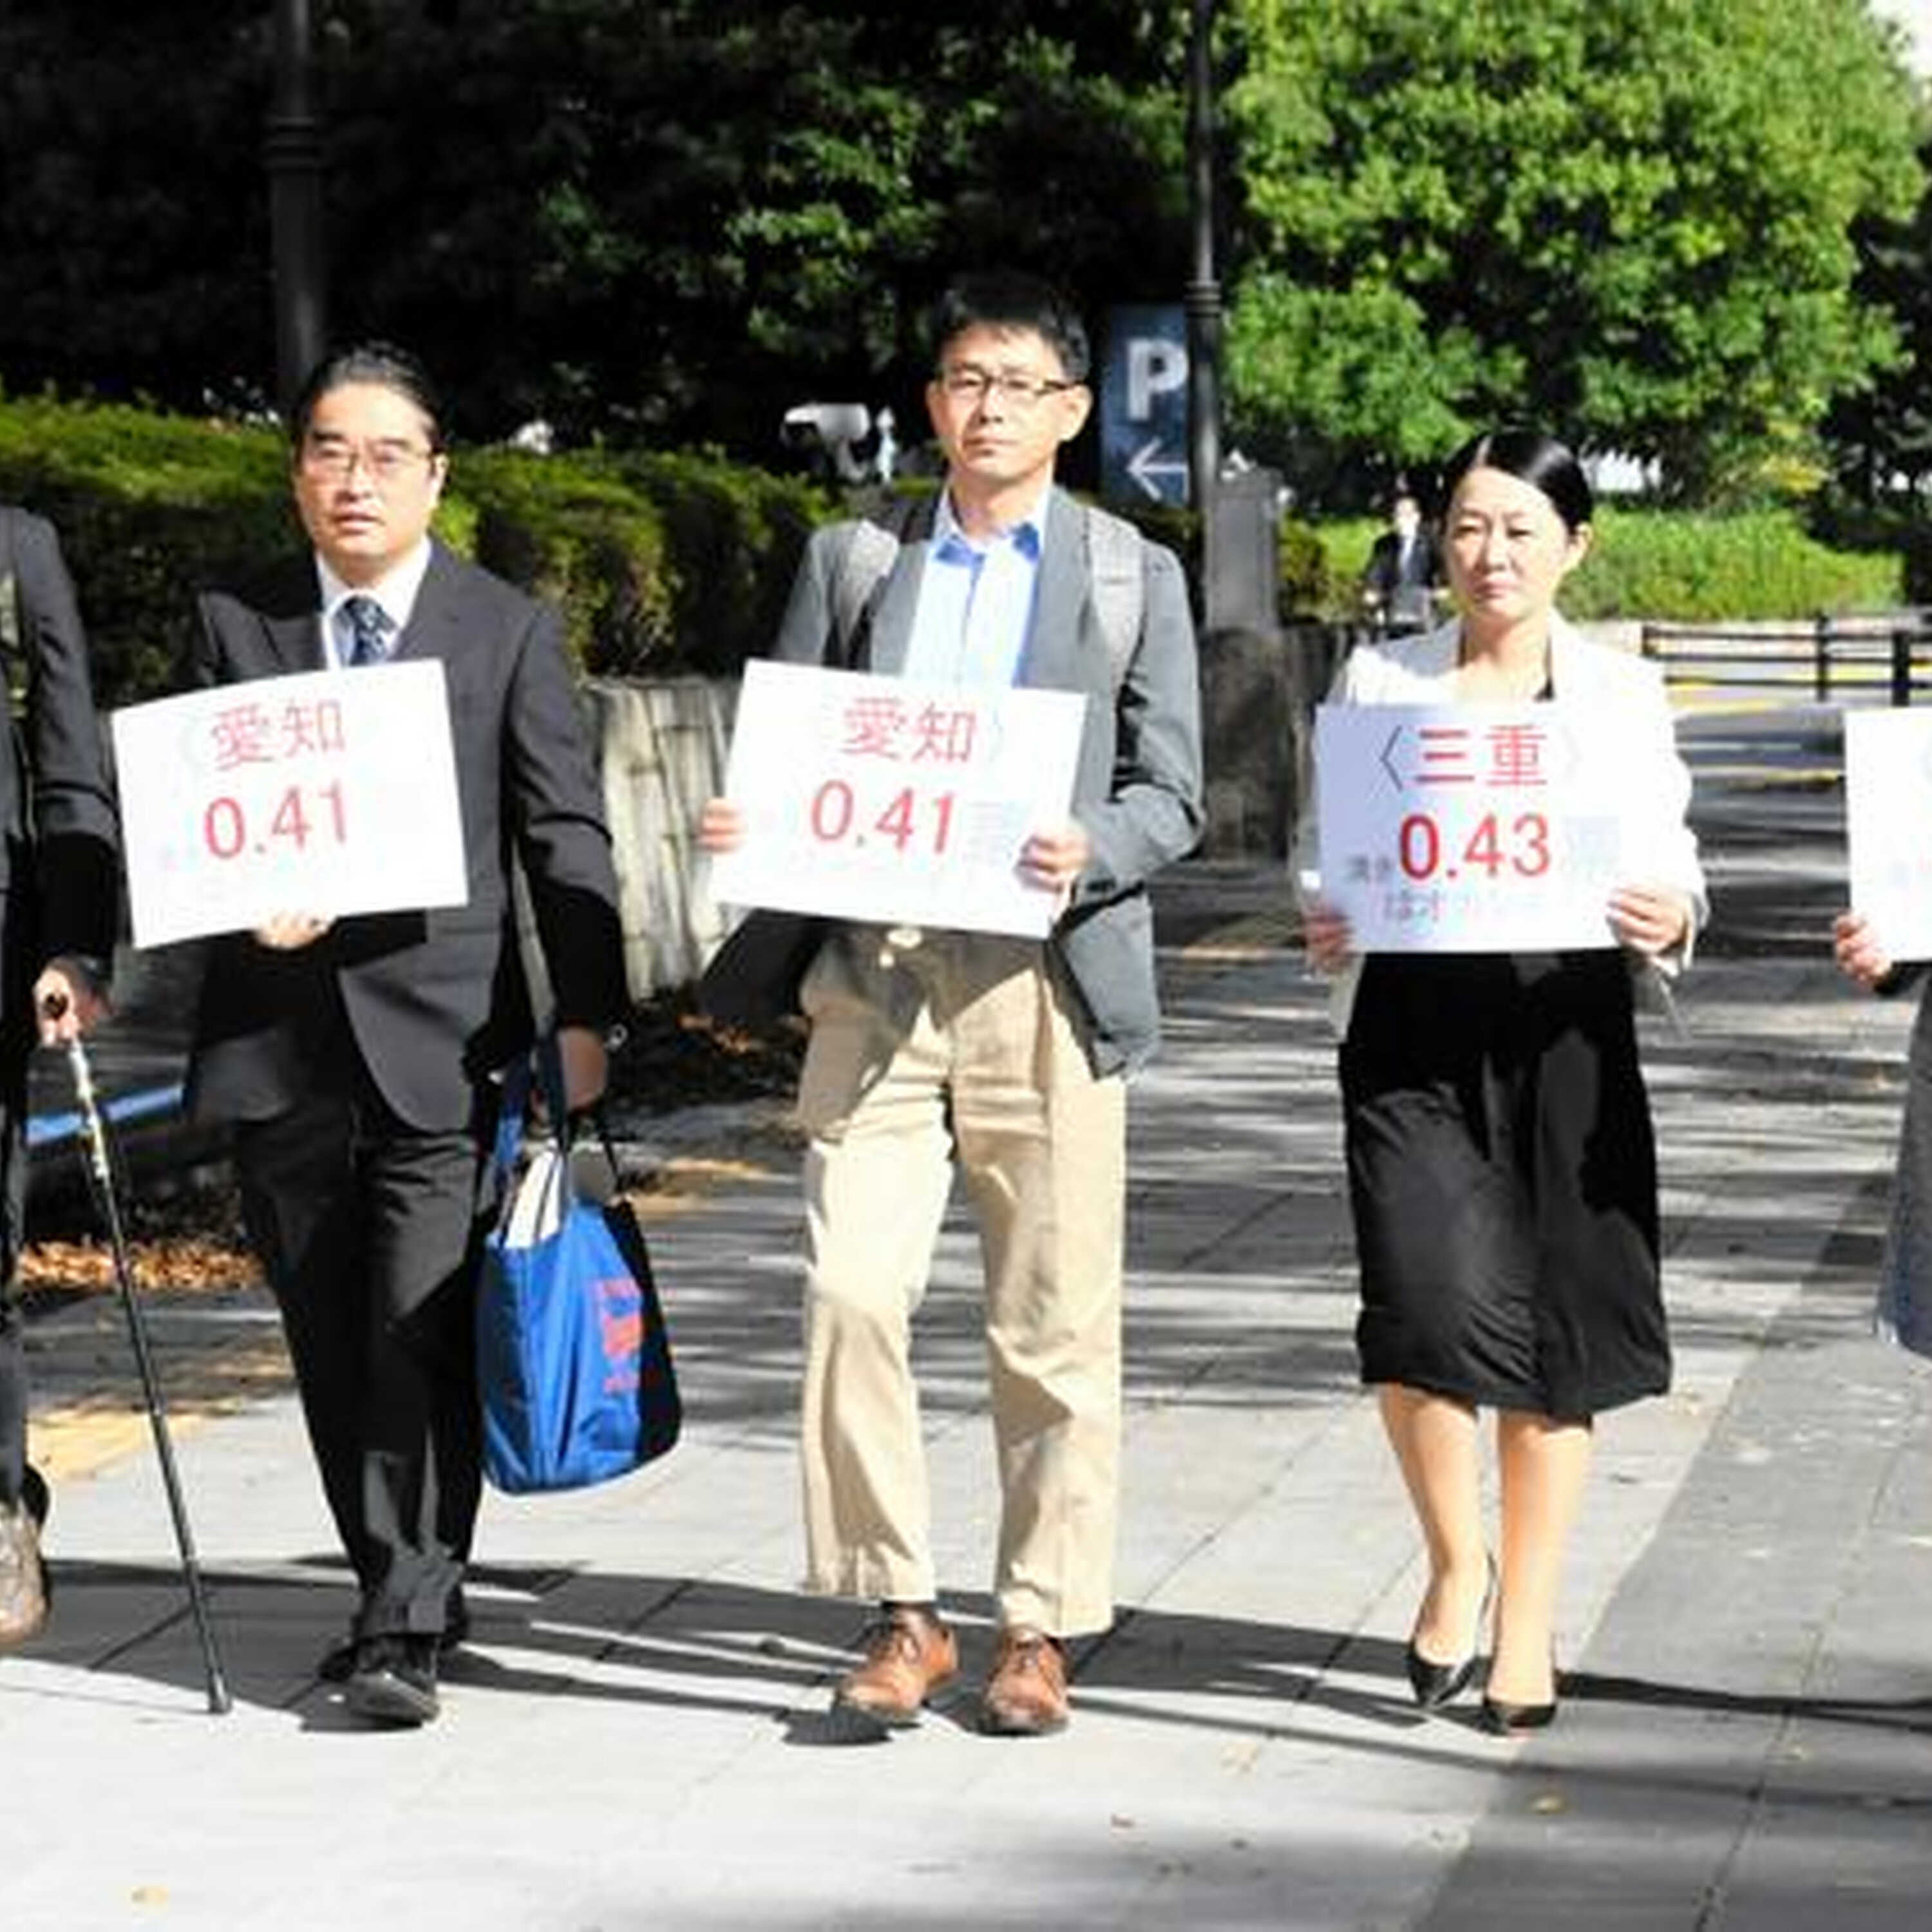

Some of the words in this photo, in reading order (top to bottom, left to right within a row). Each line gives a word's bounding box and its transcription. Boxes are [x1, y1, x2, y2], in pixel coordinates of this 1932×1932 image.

[1128, 337, 1188, 421] P
[204, 779, 346, 859] 0.41
[810, 779, 954, 855] 0.41
[1399, 812, 1551, 880] 0.43
